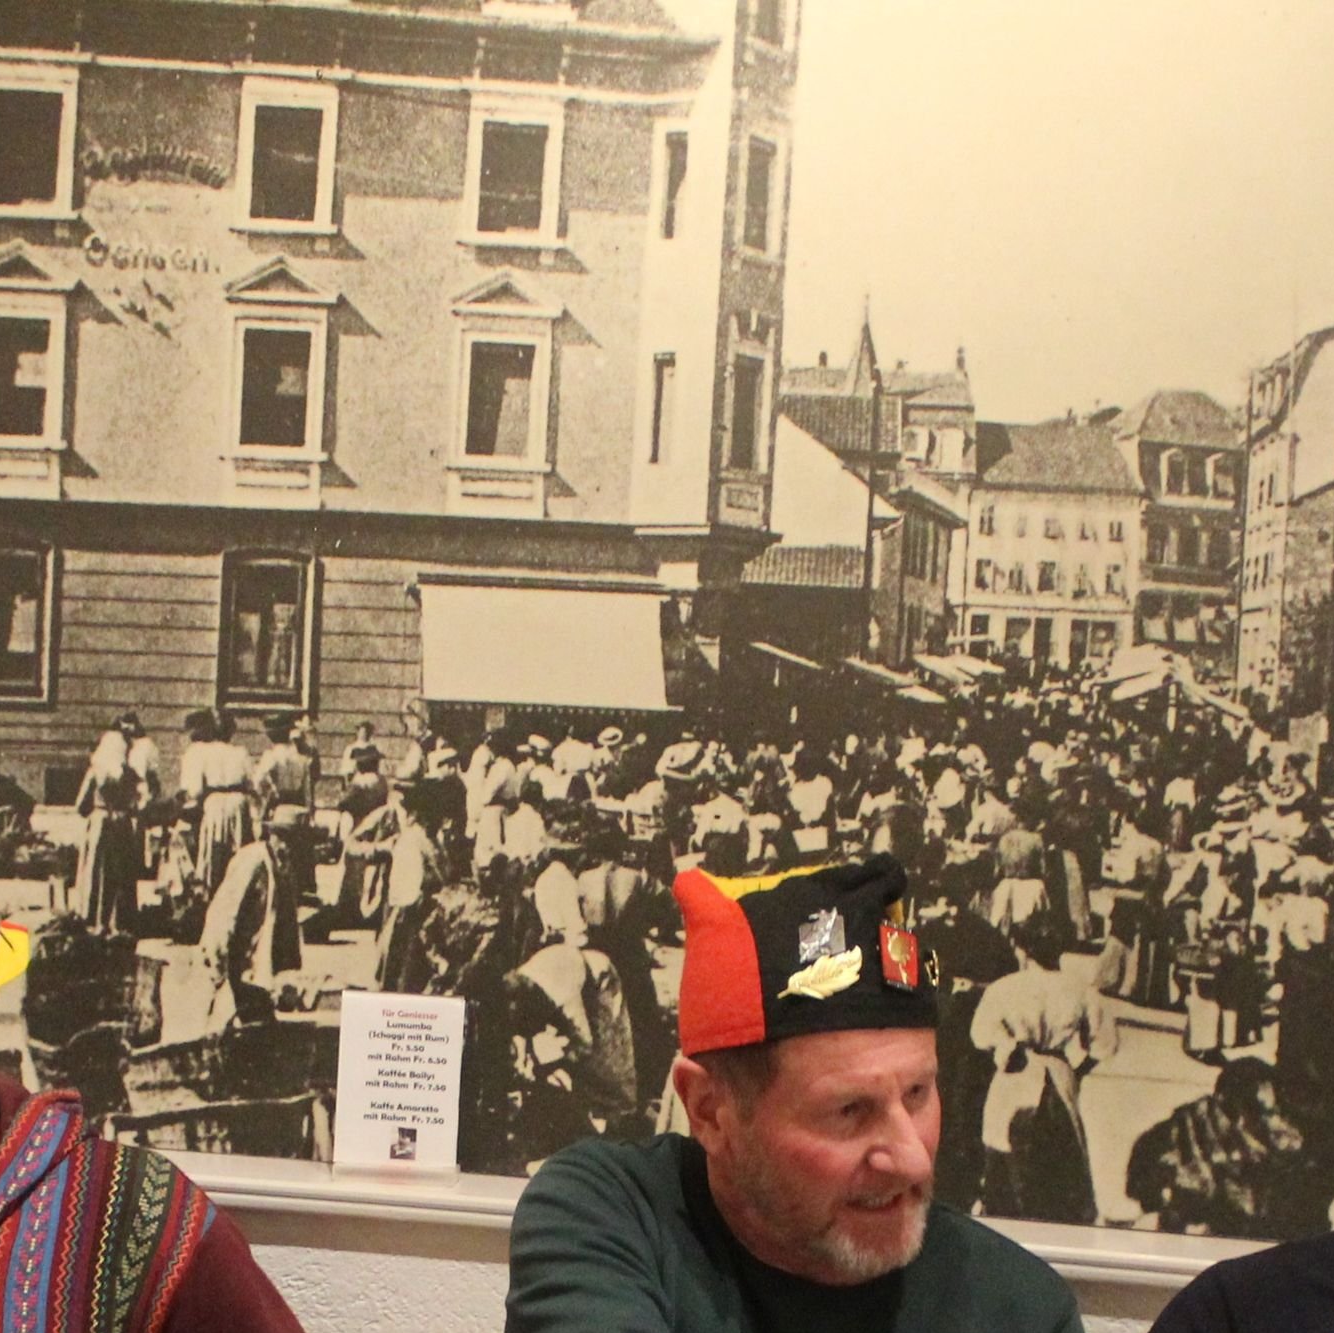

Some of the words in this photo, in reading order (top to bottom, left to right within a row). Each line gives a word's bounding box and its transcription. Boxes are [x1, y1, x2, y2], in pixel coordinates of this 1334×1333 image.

[387, 1021, 432, 1030] Lumumba
[425, 1034, 450, 1044] Rum)
[391, 1043, 403, 1051] Fr.
[385, 1054, 411, 1062] Rahm
[413, 1055, 426, 1064] Fr.
[383, 1080, 409, 1089] Rahm
[413, 1082, 426, 1090] Fr.
[397, 1104, 439, 1113] Amaretto
[381, 1113, 407, 1121] Rahm
[411, 1115, 424, 1123] Fr.
